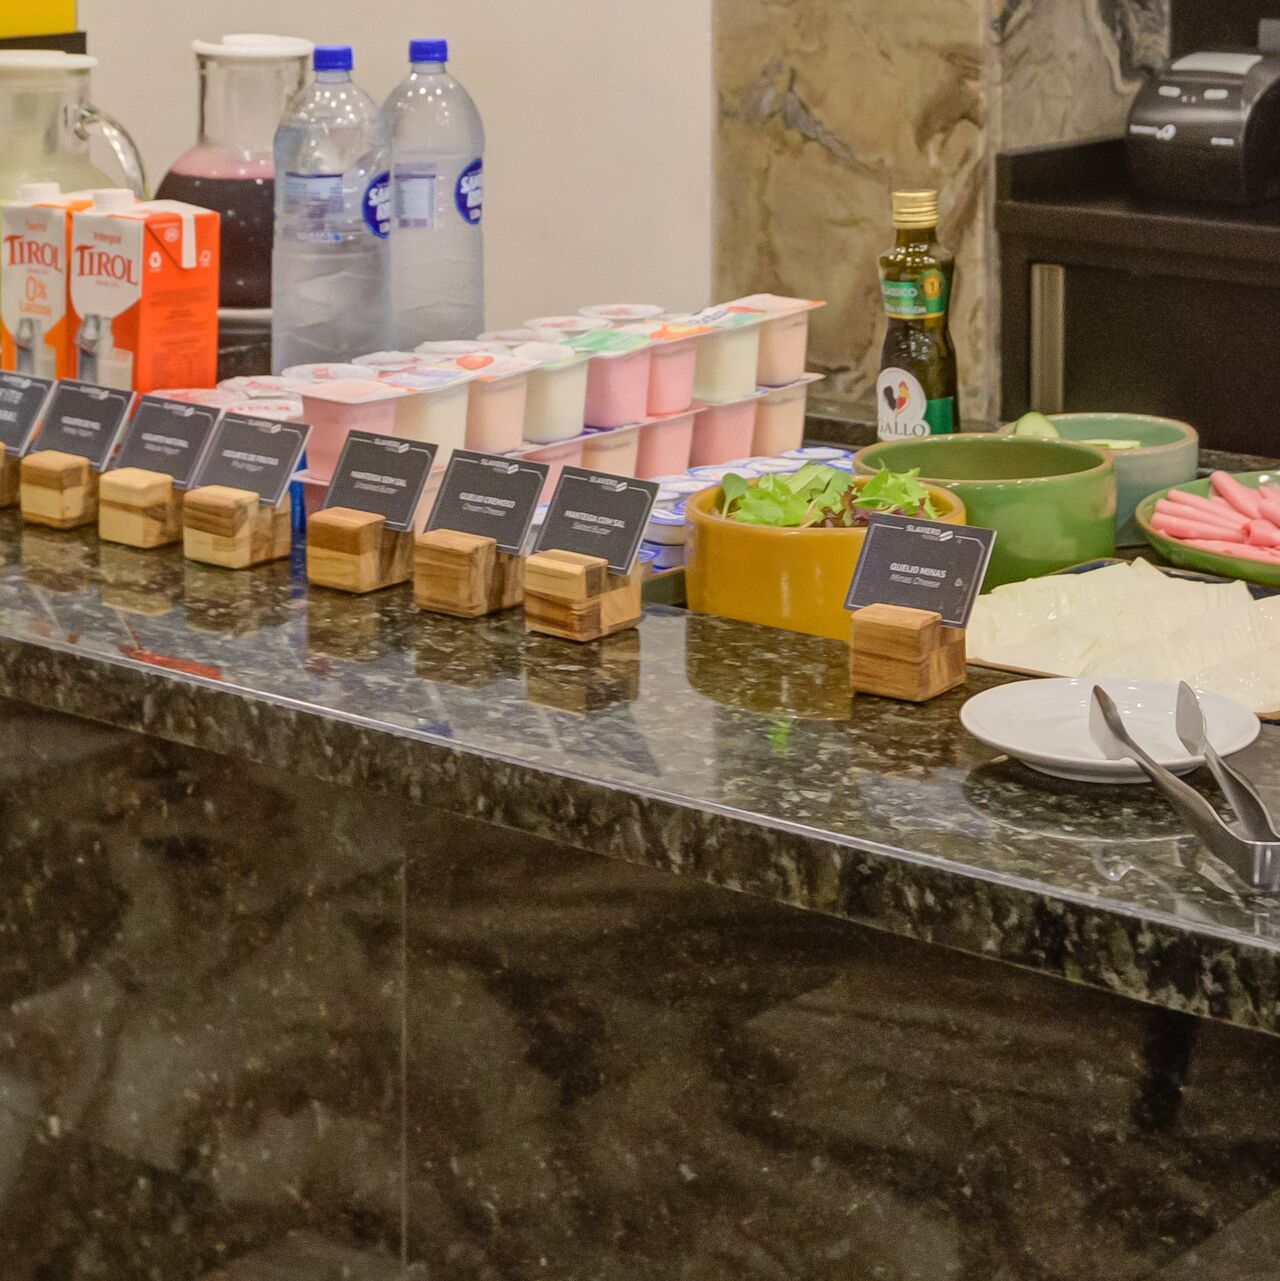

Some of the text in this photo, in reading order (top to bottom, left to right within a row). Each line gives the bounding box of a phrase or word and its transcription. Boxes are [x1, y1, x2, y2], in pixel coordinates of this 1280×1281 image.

[4, 234, 63, 273] TIROL
[75, 244, 138, 286] TIROL
[25, 275, 47, 301] 0%
[906, 524, 941, 536] SLAVIERO
[890, 562, 947, 579] QUEIJO MINAS
